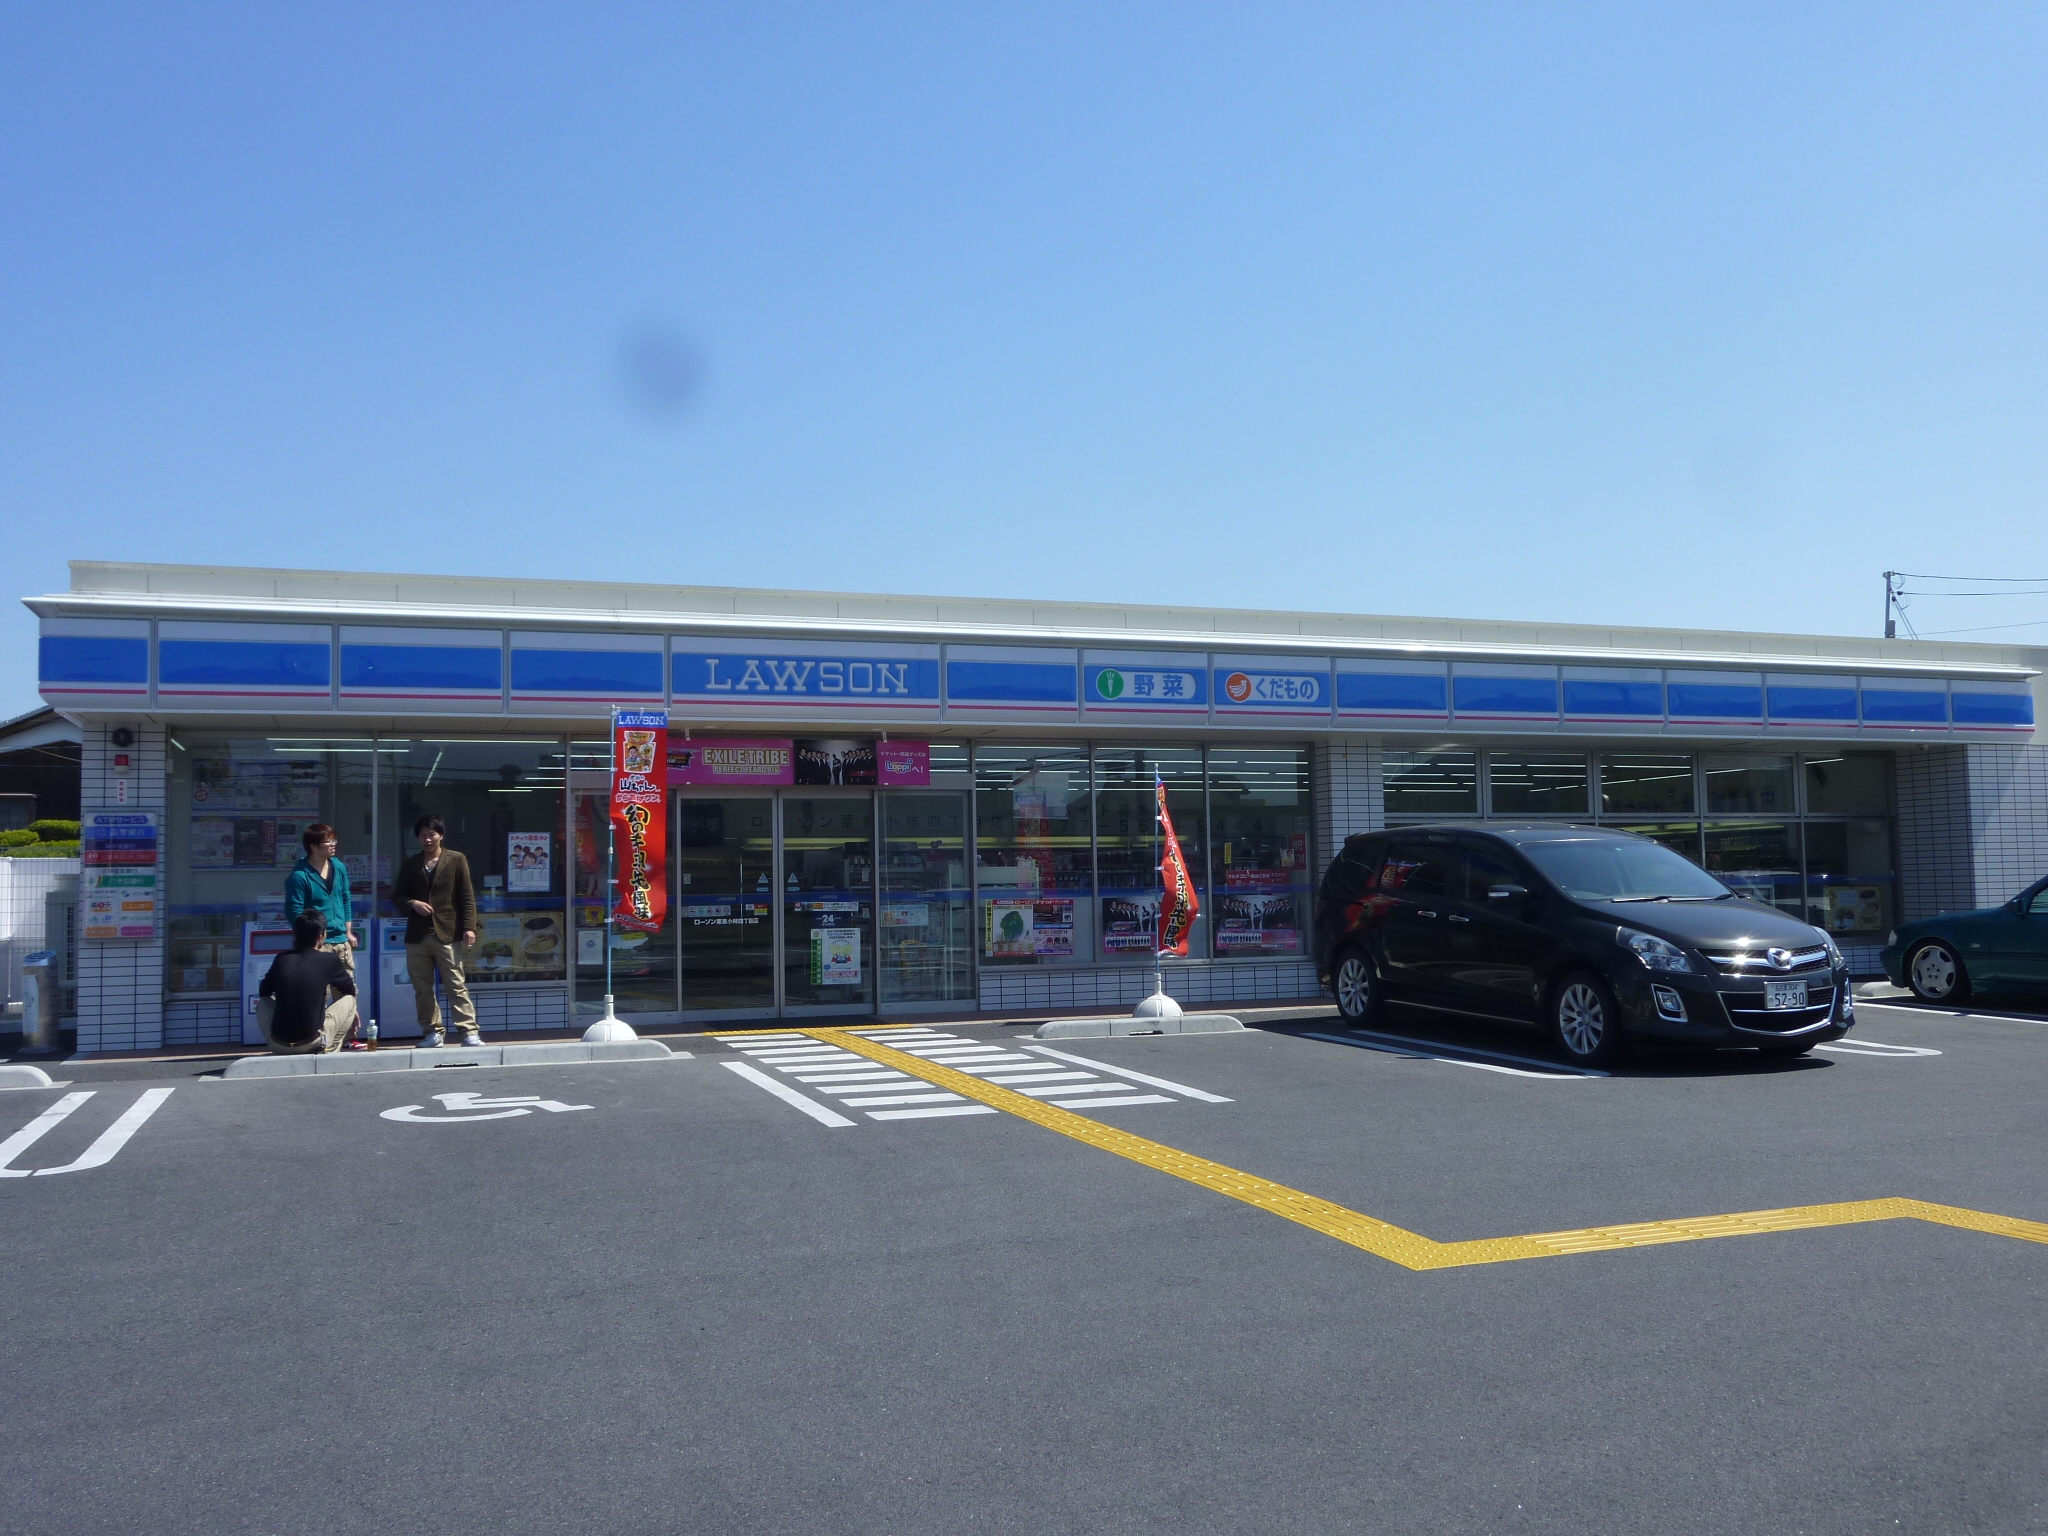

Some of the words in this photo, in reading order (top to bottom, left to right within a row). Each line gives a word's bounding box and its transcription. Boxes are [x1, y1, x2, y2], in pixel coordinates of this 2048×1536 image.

[706, 658, 909, 693] LAWSON
[1134, 674, 1183, 697] 野菜
[1255, 677, 1314, 699] くだもの
[618, 715, 664, 725] LAWSON
[703, 749, 745, 764] EXILE
[747, 749, 788, 764] TRIBE
[714, 765, 743, 773] PERFECT
[885, 758, 913, 774] Loppi
[620, 779, 656, 791] 山ちゃん
[96, 816, 145, 824] ATMサービス
[624, 803, 651, 919] 幻の手羽先風味
[822, 915, 834, 923] 24
[1775, 992, 1805, 1006] 52-90
